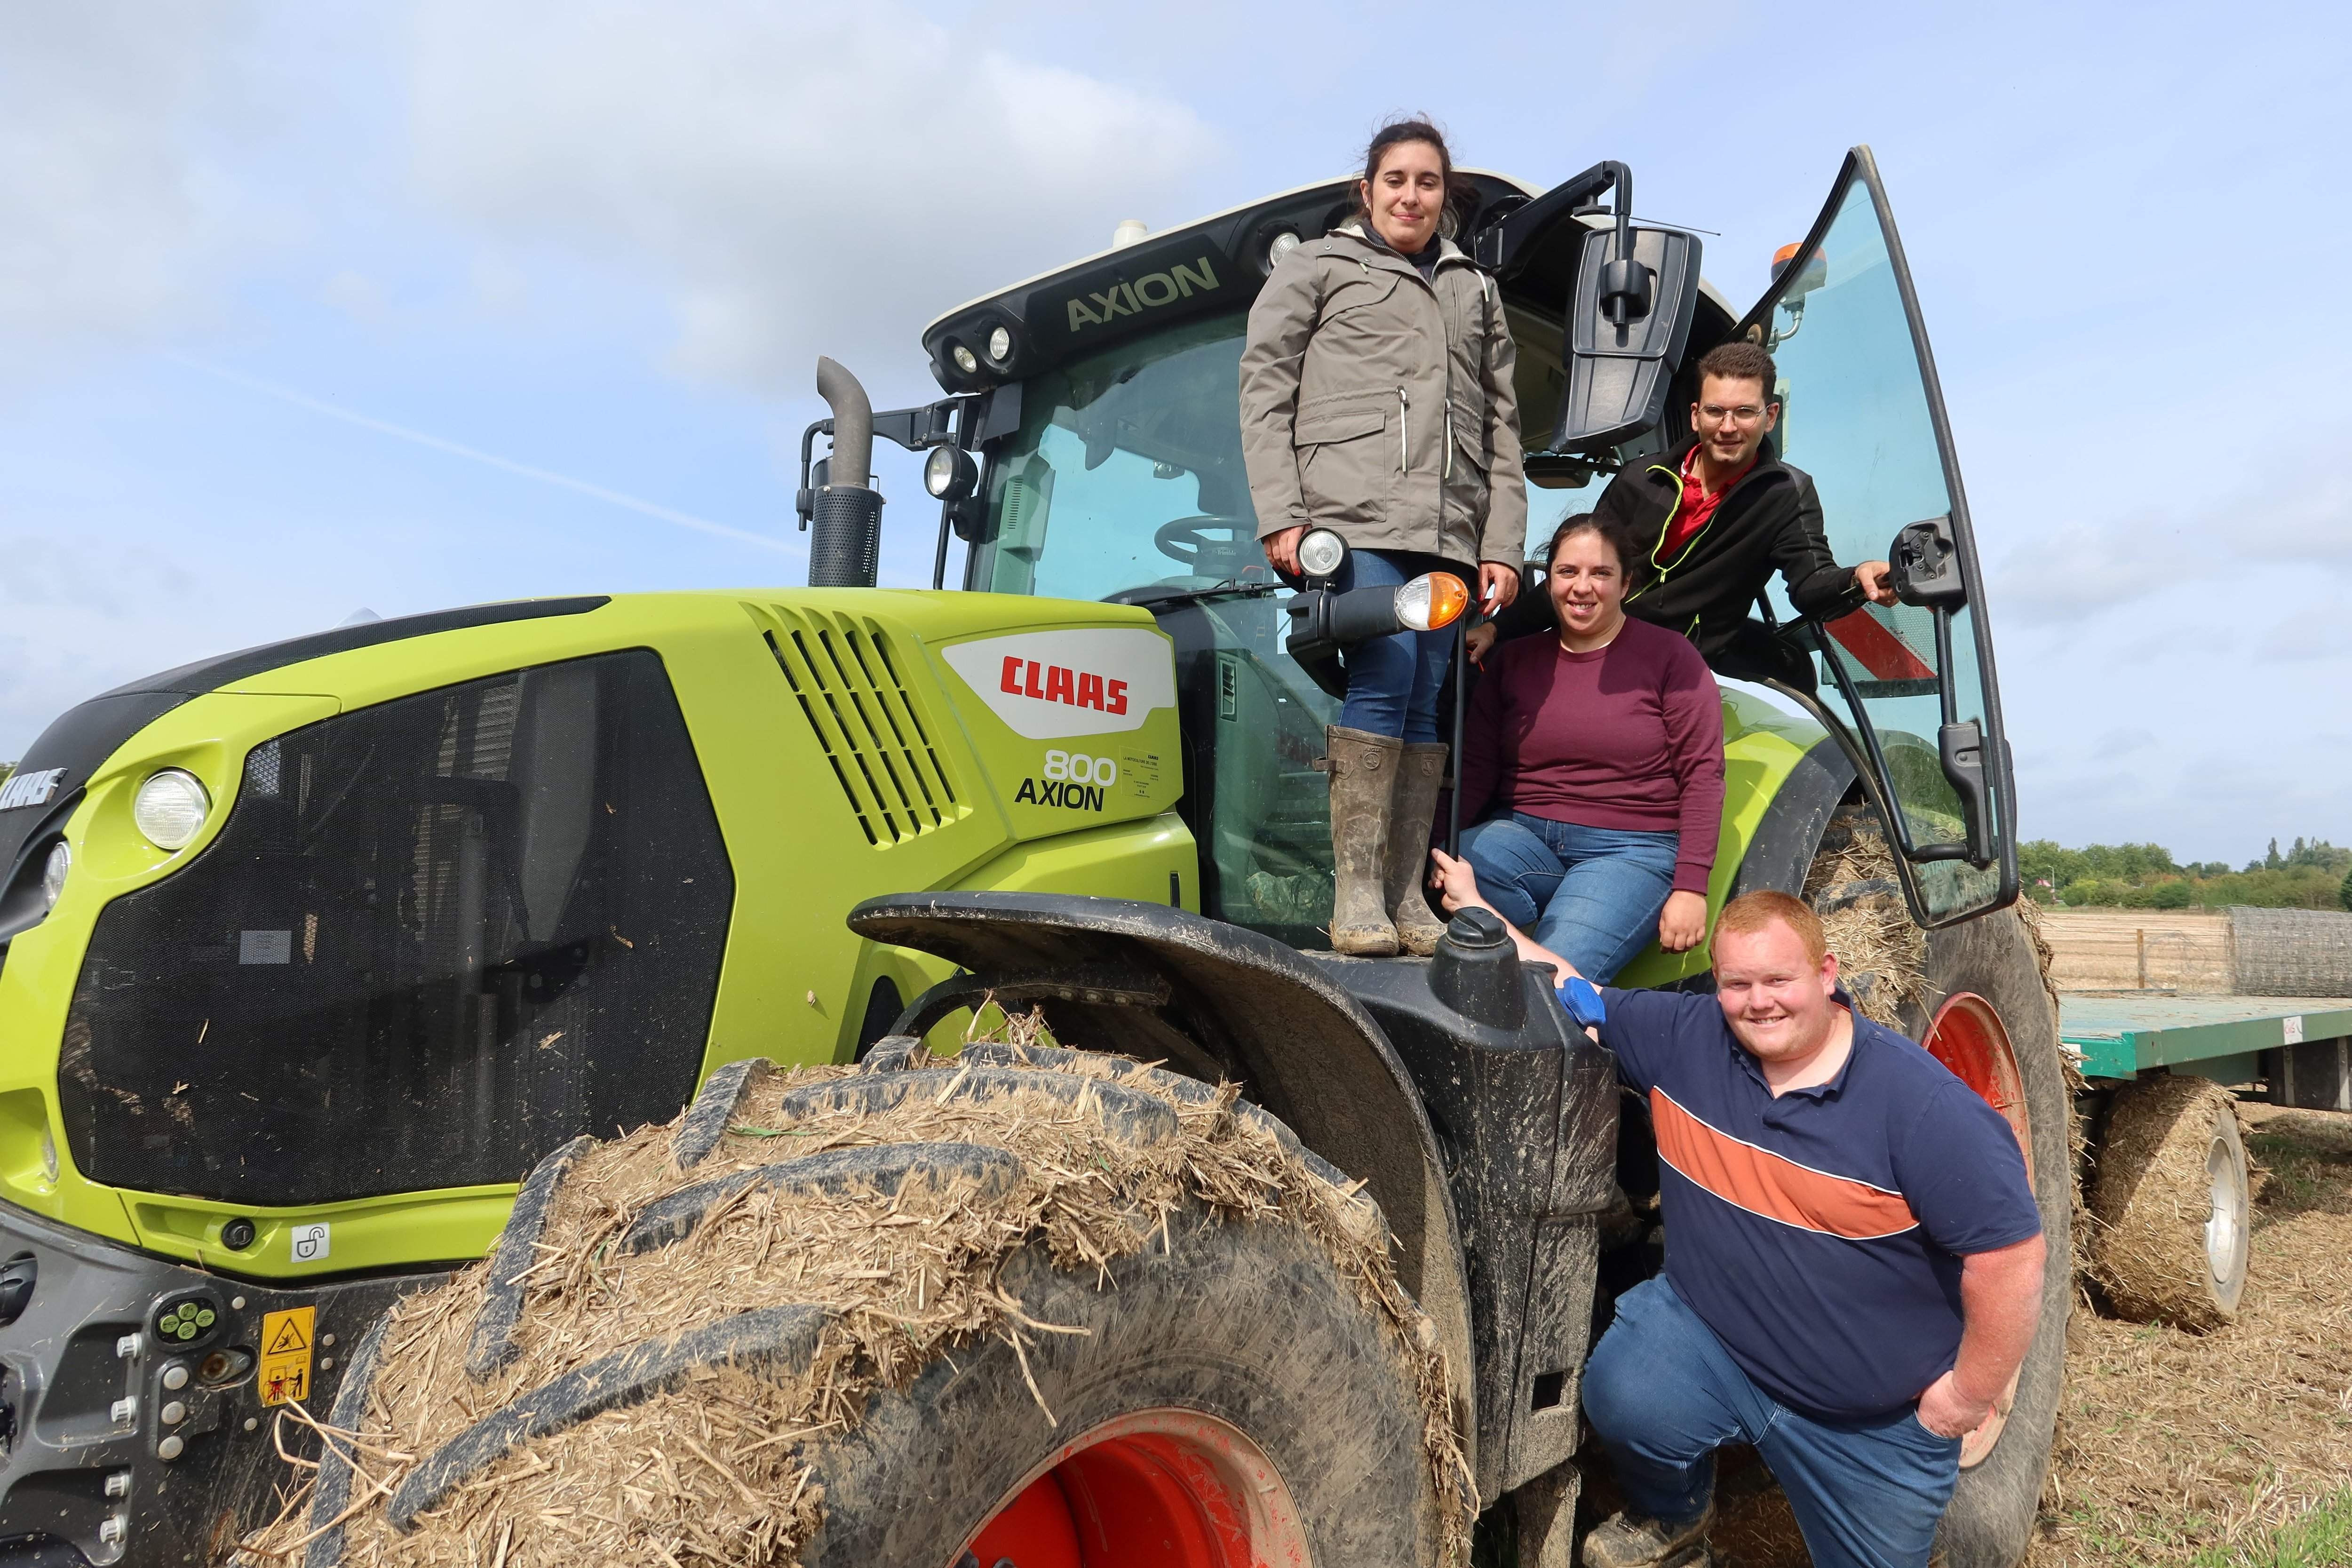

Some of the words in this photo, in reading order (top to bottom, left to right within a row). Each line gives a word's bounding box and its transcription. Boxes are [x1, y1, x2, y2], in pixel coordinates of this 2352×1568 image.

[1067, 256, 1220, 333] AXION
[1001, 656, 1128, 716] CLAAS
[1044, 749, 1116, 787] 800
[1015, 778, 1104, 812] AXION
